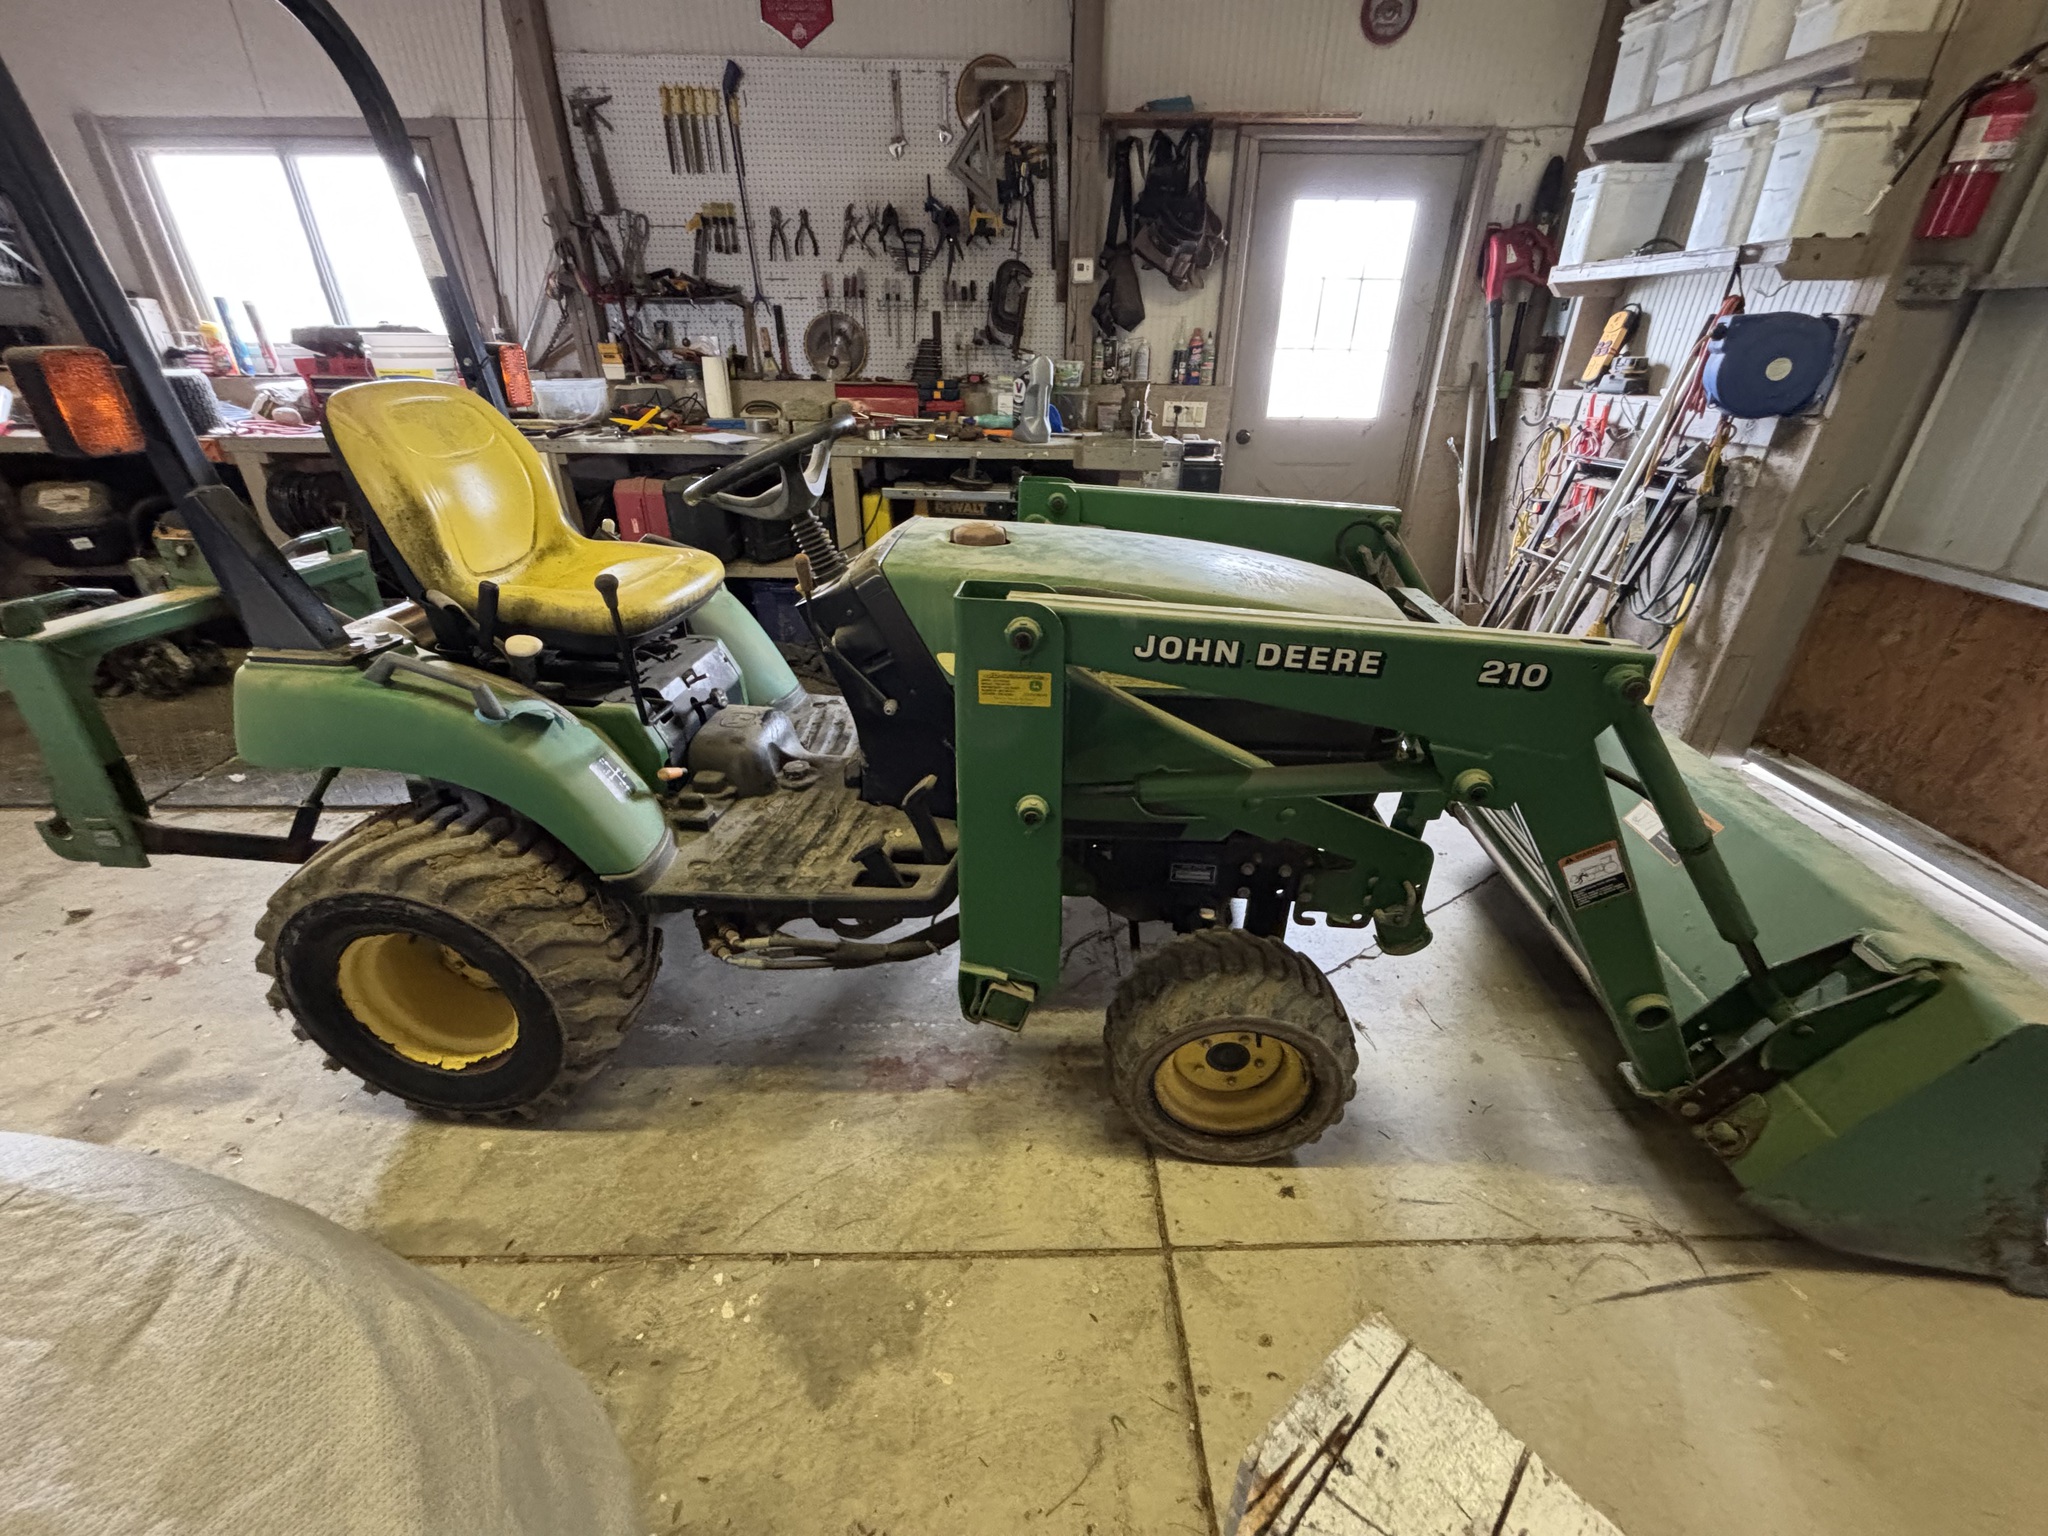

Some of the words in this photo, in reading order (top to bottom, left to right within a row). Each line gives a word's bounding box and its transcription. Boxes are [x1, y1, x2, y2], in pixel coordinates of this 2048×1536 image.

[1133, 634, 1242, 665] JOHN
[1256, 642, 1384, 676] DEERE
[1477, 659, 1549, 688] 210
